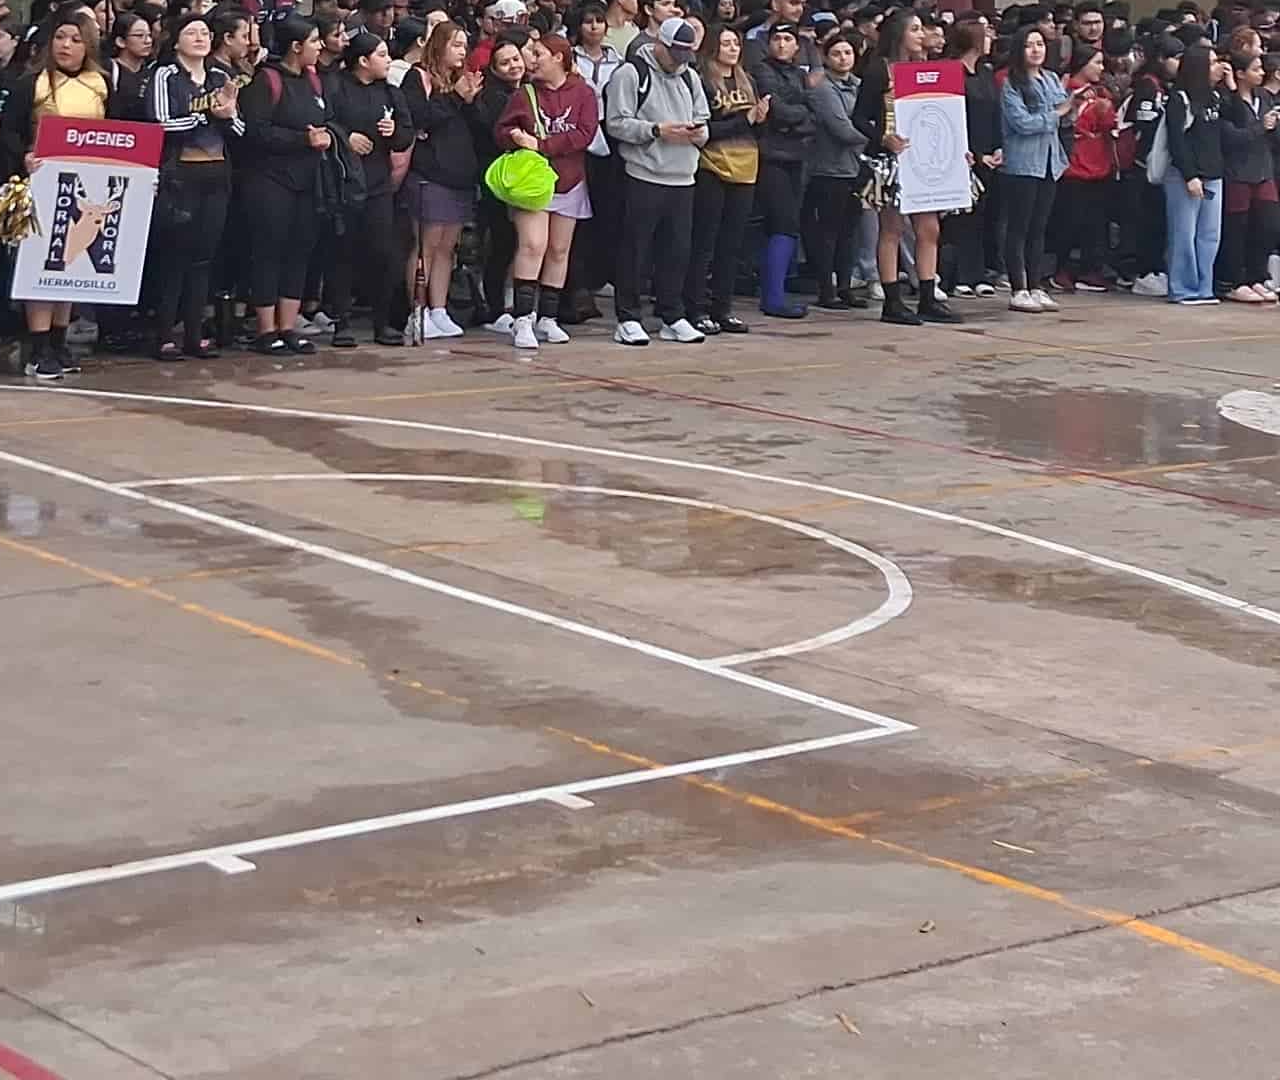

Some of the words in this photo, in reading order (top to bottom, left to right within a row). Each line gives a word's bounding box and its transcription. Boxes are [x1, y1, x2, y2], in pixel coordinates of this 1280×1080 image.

[66, 129, 135, 148] ByCENES
[50, 182, 74, 262] NORMAL
[99, 188, 122, 264] ONORA
[38, 277, 117, 290] HERMOSILLO
